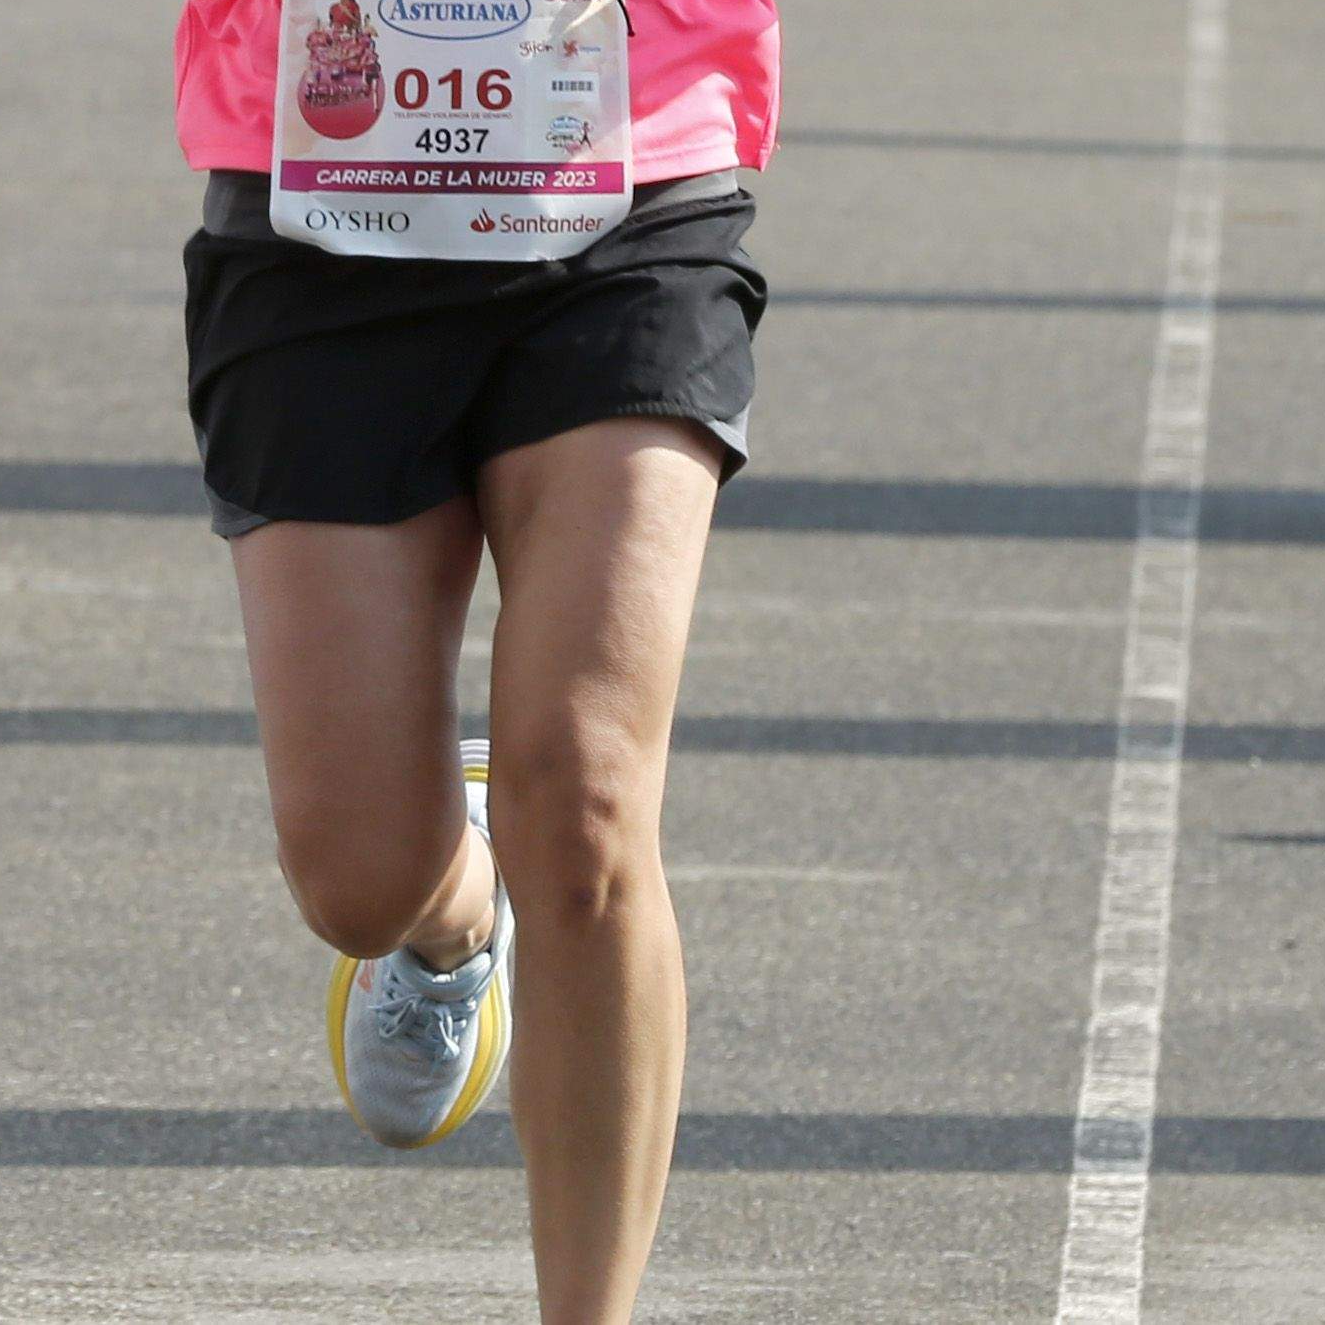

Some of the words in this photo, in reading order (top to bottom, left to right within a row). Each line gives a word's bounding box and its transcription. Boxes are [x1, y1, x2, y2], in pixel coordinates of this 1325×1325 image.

[394, 68, 513, 111] 016
[415, 127, 489, 154] 4937
[316, 168, 408, 185] CARRERA
[413, 169, 441, 186] DE
[447, 169, 472, 186] LA
[478, 169, 545, 186] MUJER
[552, 170, 596, 187] 2023
[305, 208, 410, 233] OYSHO
[499, 212, 603, 234] Santander
